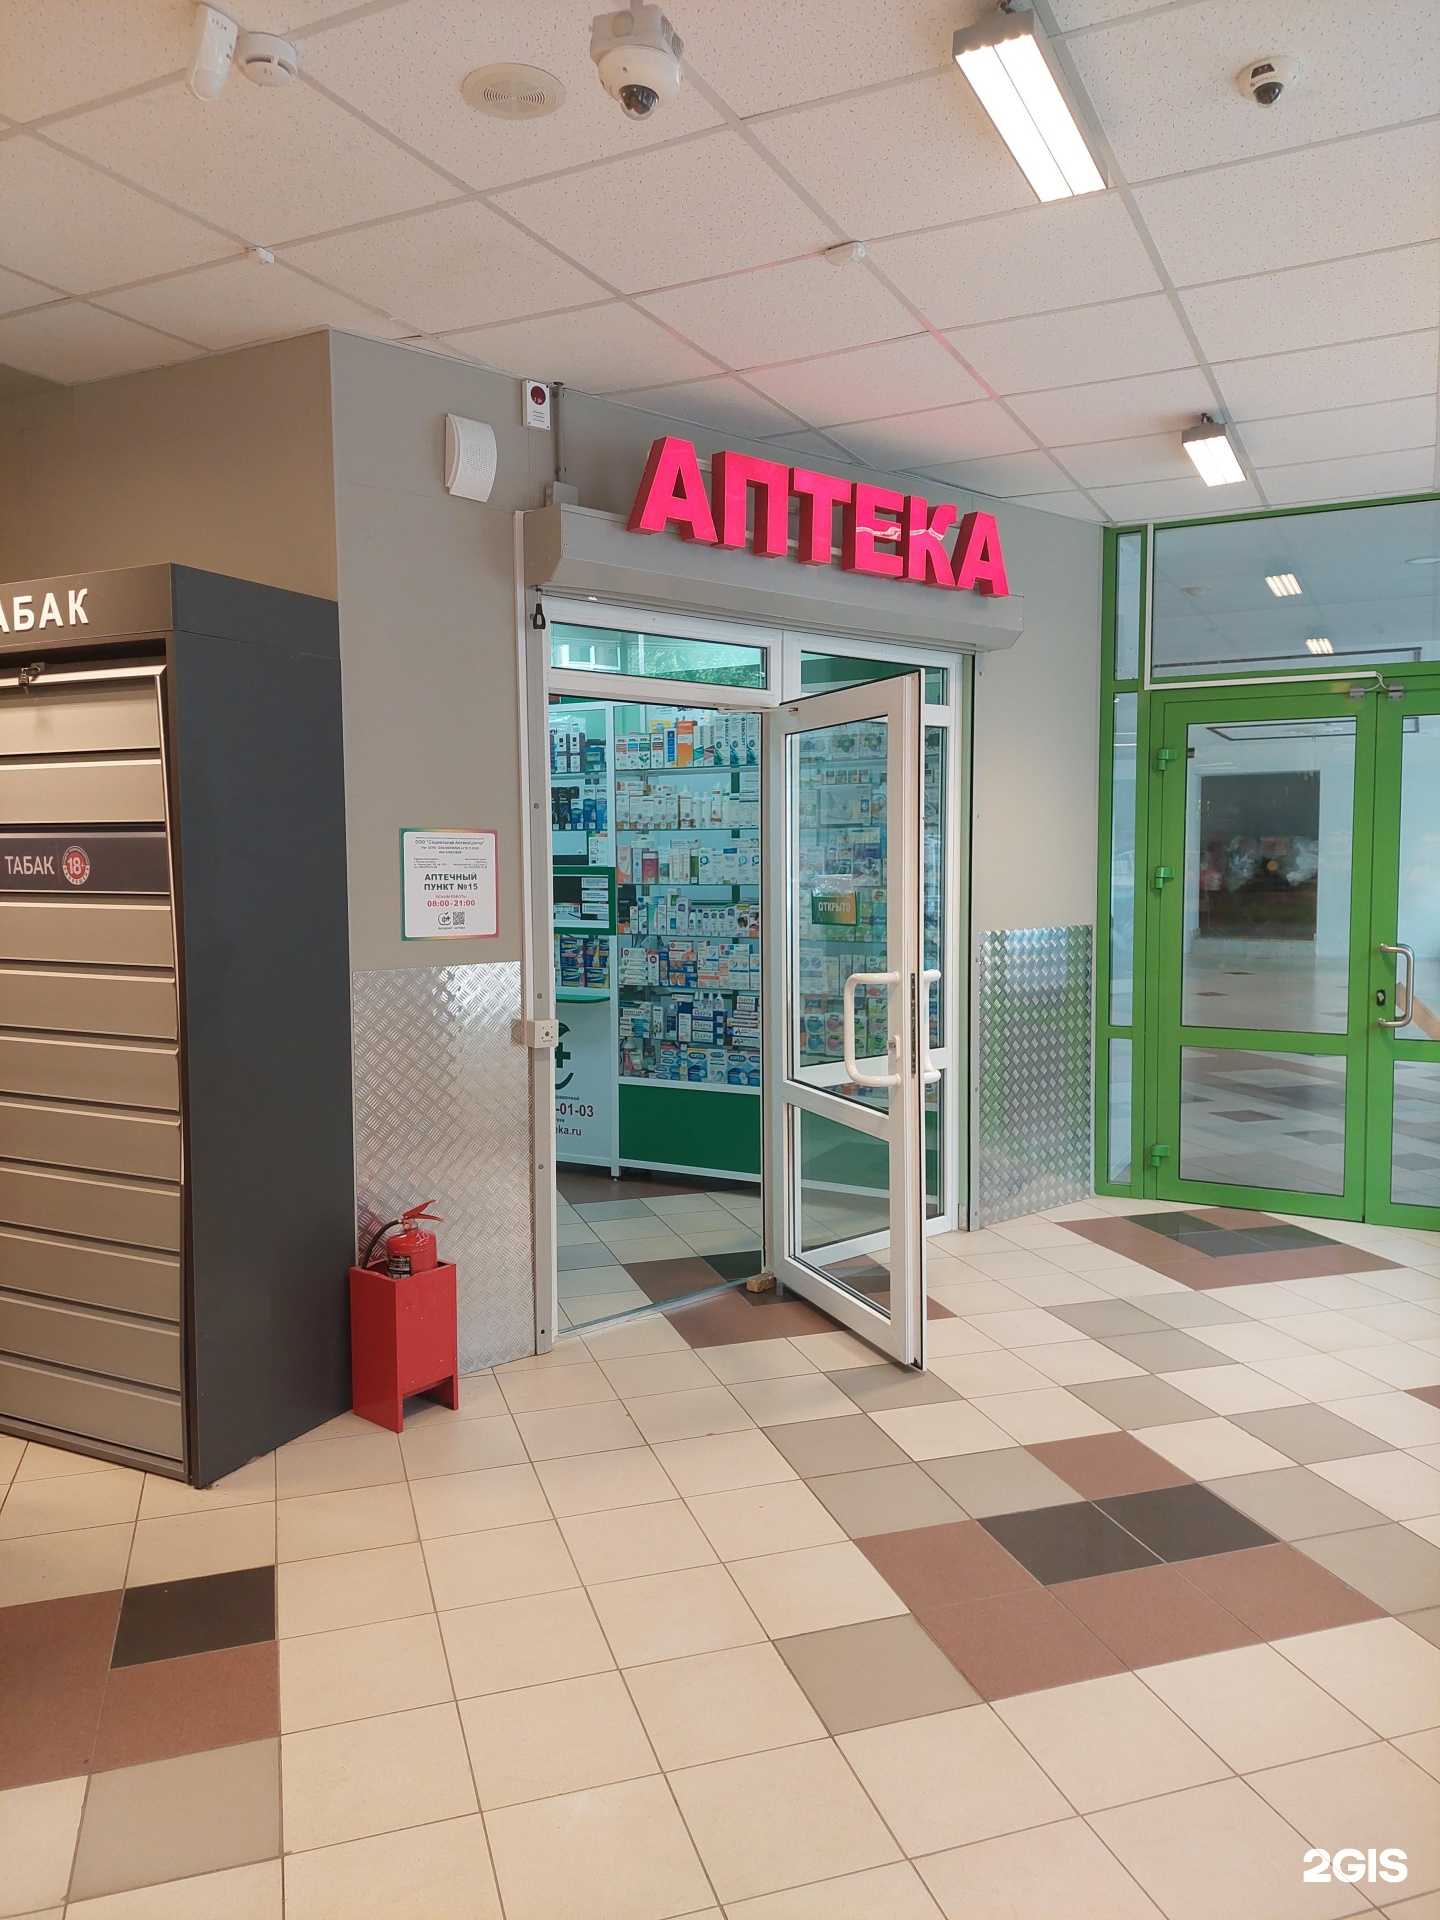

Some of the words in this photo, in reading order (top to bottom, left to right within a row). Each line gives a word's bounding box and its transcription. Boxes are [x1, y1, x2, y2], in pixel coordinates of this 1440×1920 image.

[626, 435, 1010, 598] АПТЕКА
[4, 855, 55, 875] ТАБАК
[424, 872, 478, 881] АПТЕЧНЫЙ
[424, 883, 454, 891] ПУНКТ
[457, 883, 478, 891] №15
[818, 902, 851, 912] ОТКРЫТО
[556, 1124, 582, 1136] ka.ru
